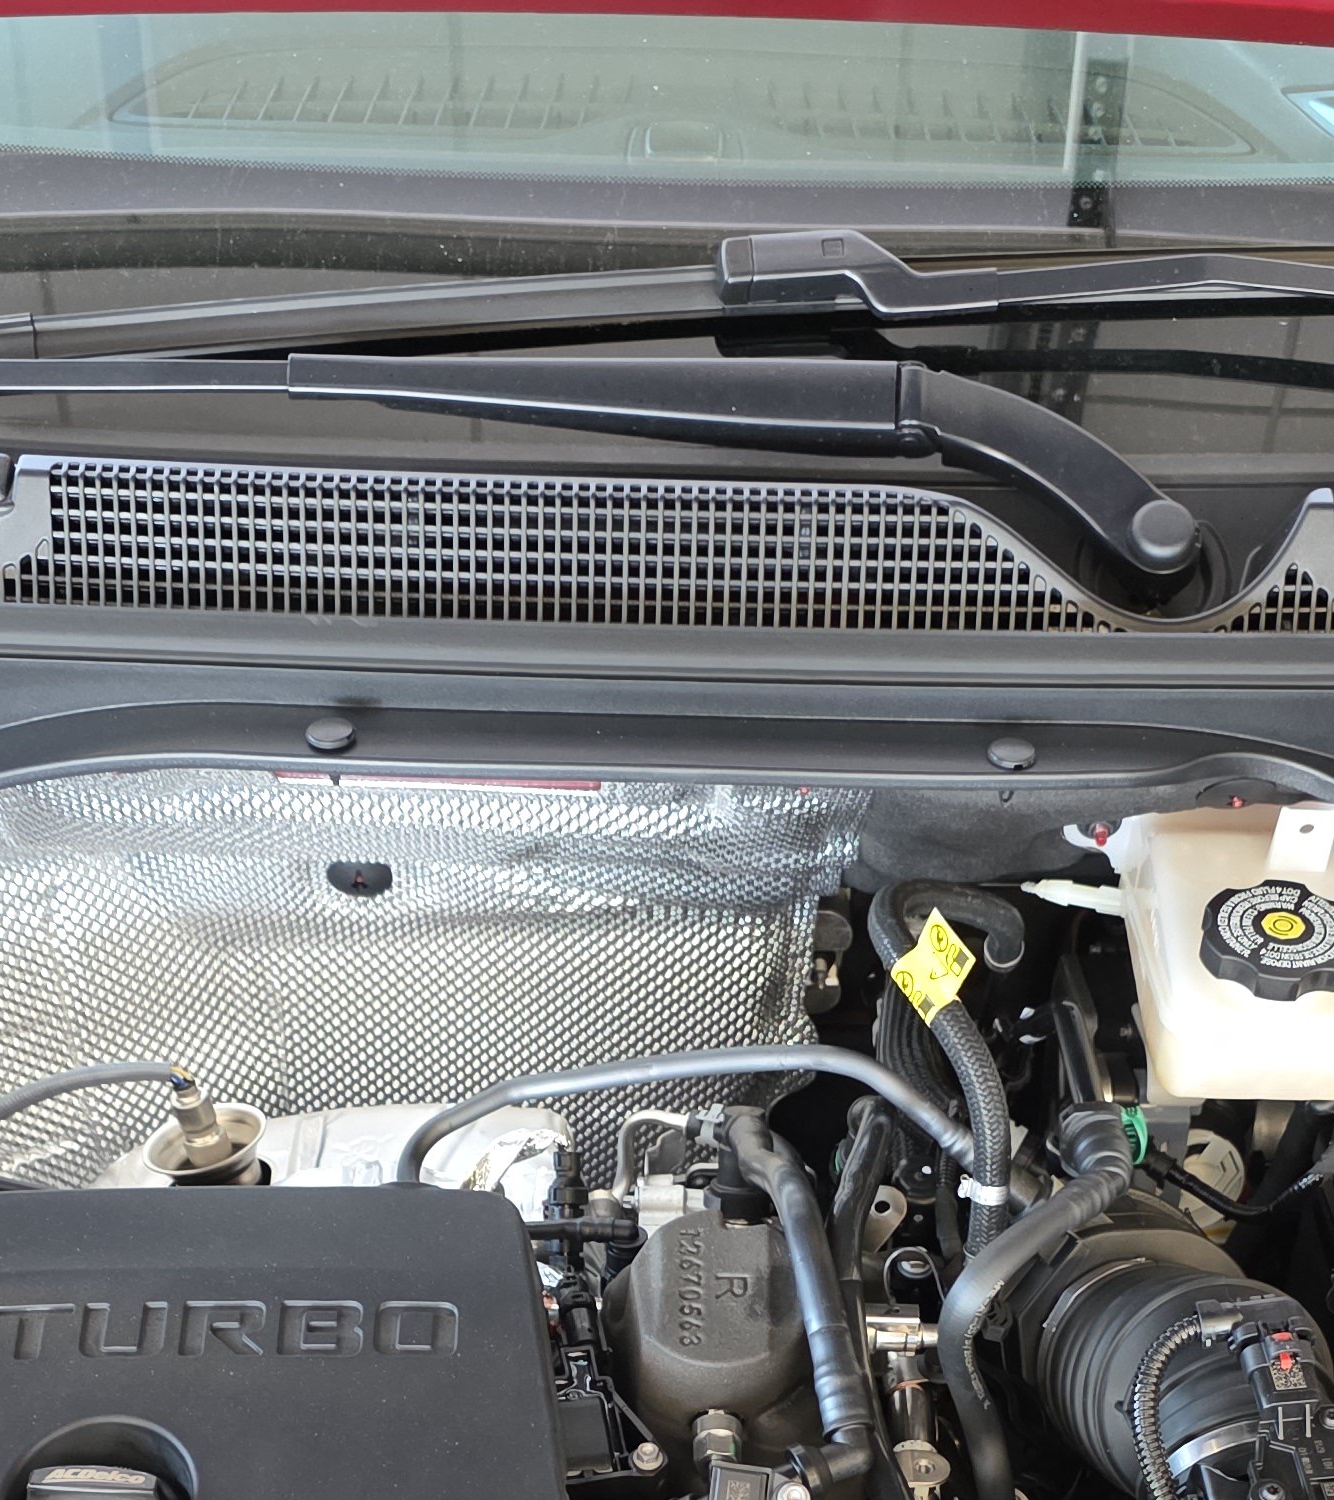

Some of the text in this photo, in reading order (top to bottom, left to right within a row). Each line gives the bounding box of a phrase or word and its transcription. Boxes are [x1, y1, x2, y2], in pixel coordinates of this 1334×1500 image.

[1250, 886, 1276, 896] FLUID
[1275, 886, 1283, 894] 4
[1281, 887, 1301, 898] DOT
[1279, 895, 1299, 904] CAP
[1237, 935, 1258, 950] ONLY
[1259, 947, 1268, 956] 4
[1265, 949, 1281, 960] DOT
[715, 1272, 750, 1300] R
[42, 1467, 146, 1485] ACDelco
